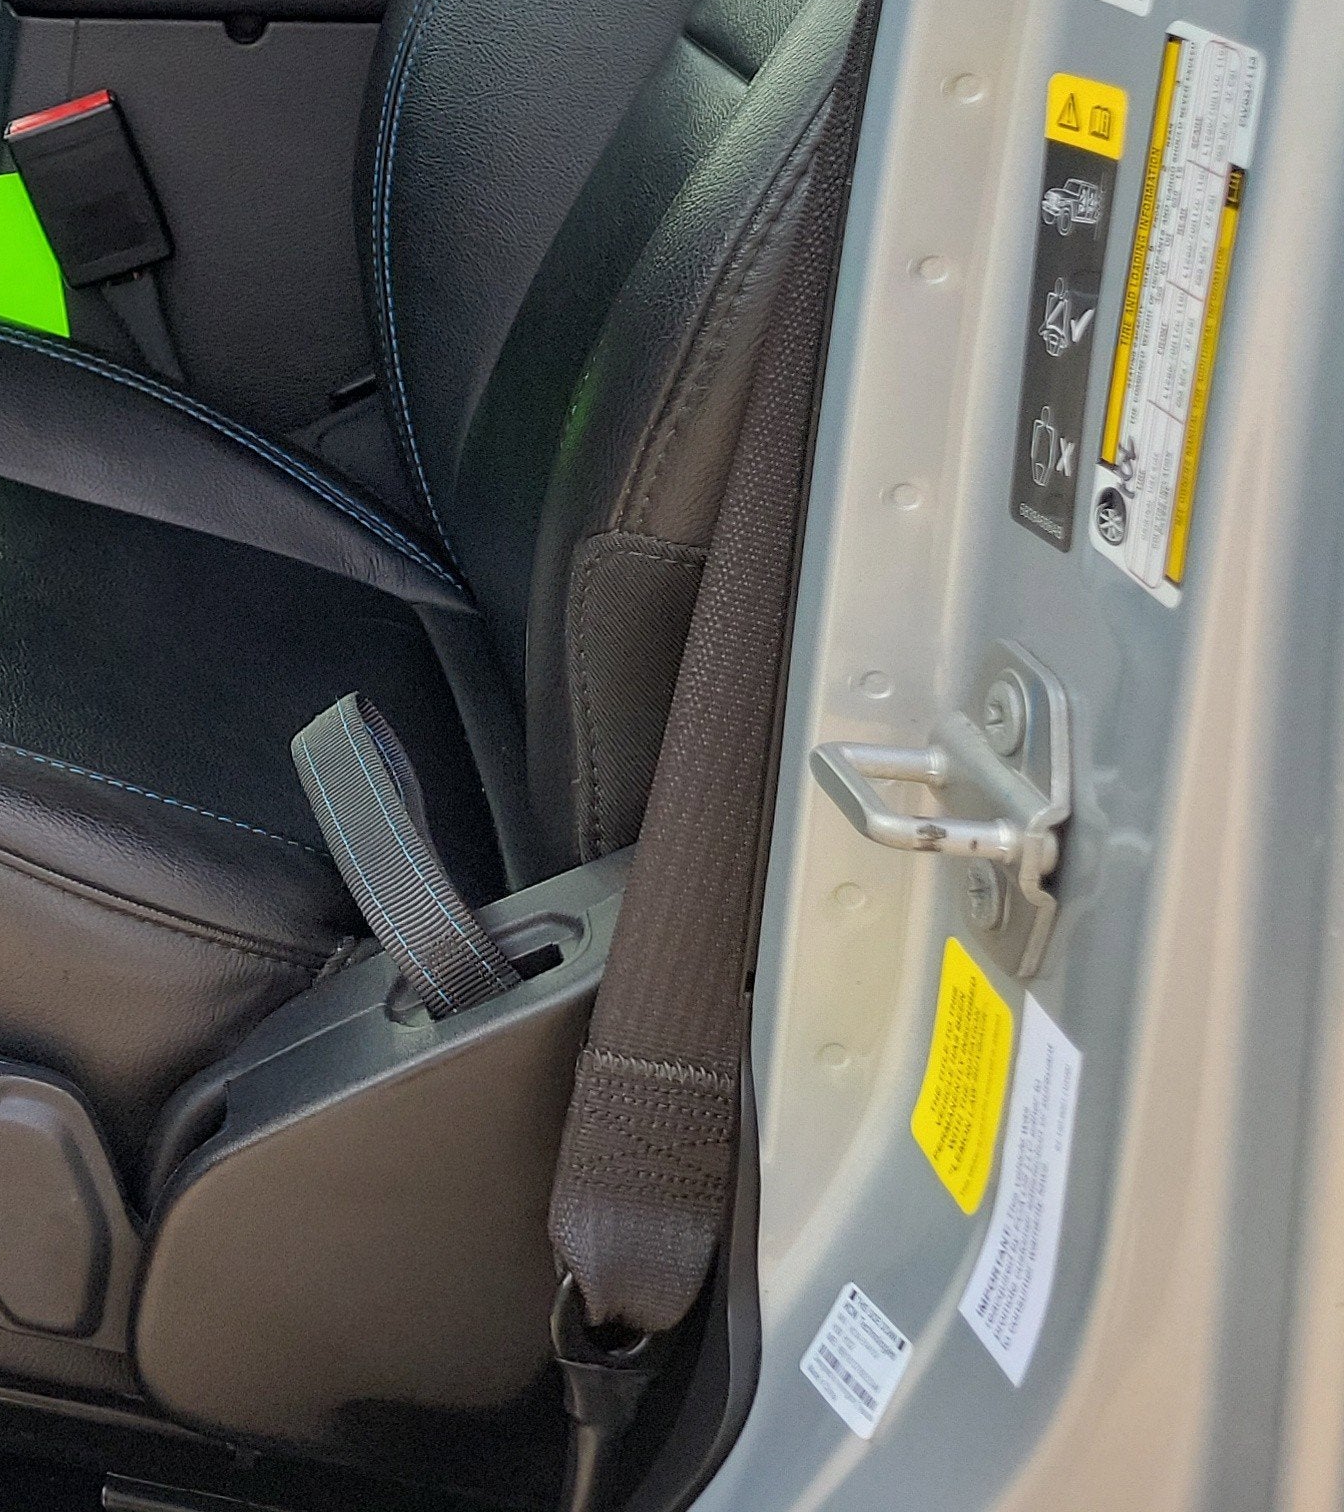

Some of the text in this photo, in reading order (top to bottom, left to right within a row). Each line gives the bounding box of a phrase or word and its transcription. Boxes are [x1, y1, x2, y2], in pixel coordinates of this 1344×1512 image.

[1119, 144, 1160, 349] TIRE AND LOADING INFORMATION
